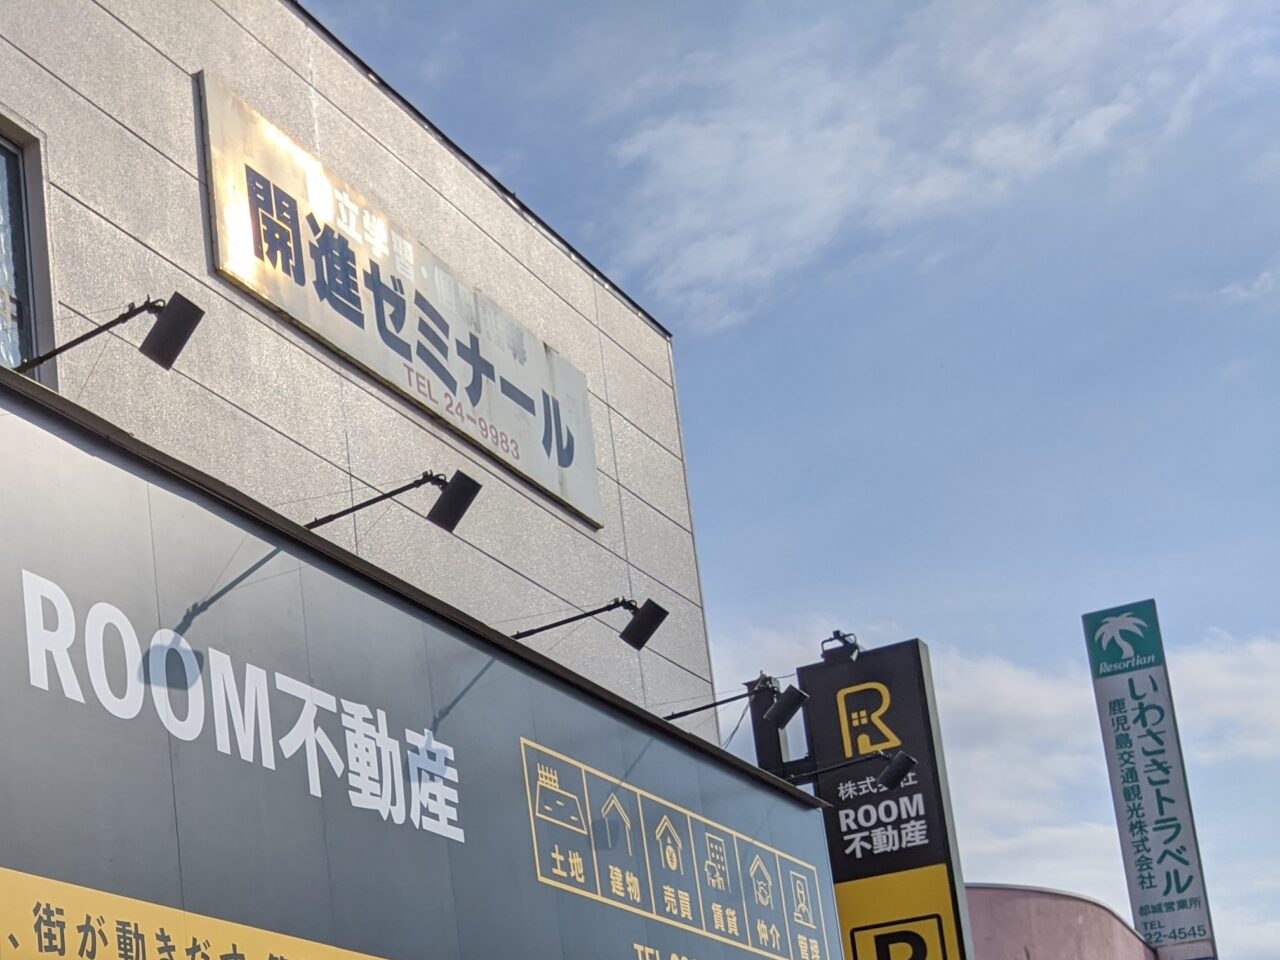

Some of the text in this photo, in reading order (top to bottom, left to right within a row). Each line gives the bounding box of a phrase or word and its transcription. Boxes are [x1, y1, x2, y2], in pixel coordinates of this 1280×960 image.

[244, 163, 575, 468] 開進ゼミナール
[403, 364, 520, 459] TEL 24-9983
[21, 568, 465, 843] ROOM不動産
[837, 771, 918, 801] 株式社
[1108, 698, 1157, 890] 鹿児島交通観光株式会社
[1128, 674, 1194, 897] いわさきトラベル
[838, 793, 926, 832] ROOM
[843, 819, 929, 859] 不動産
[551, 845, 585, 884] 土地
[609, 864, 641, 903] 建物
[663, 885, 693, 921] 売買
[756, 919, 780, 950] 仲介
[1141, 920, 1166, 932] TEL
[1144, 924, 1207, 945] 22-4545
